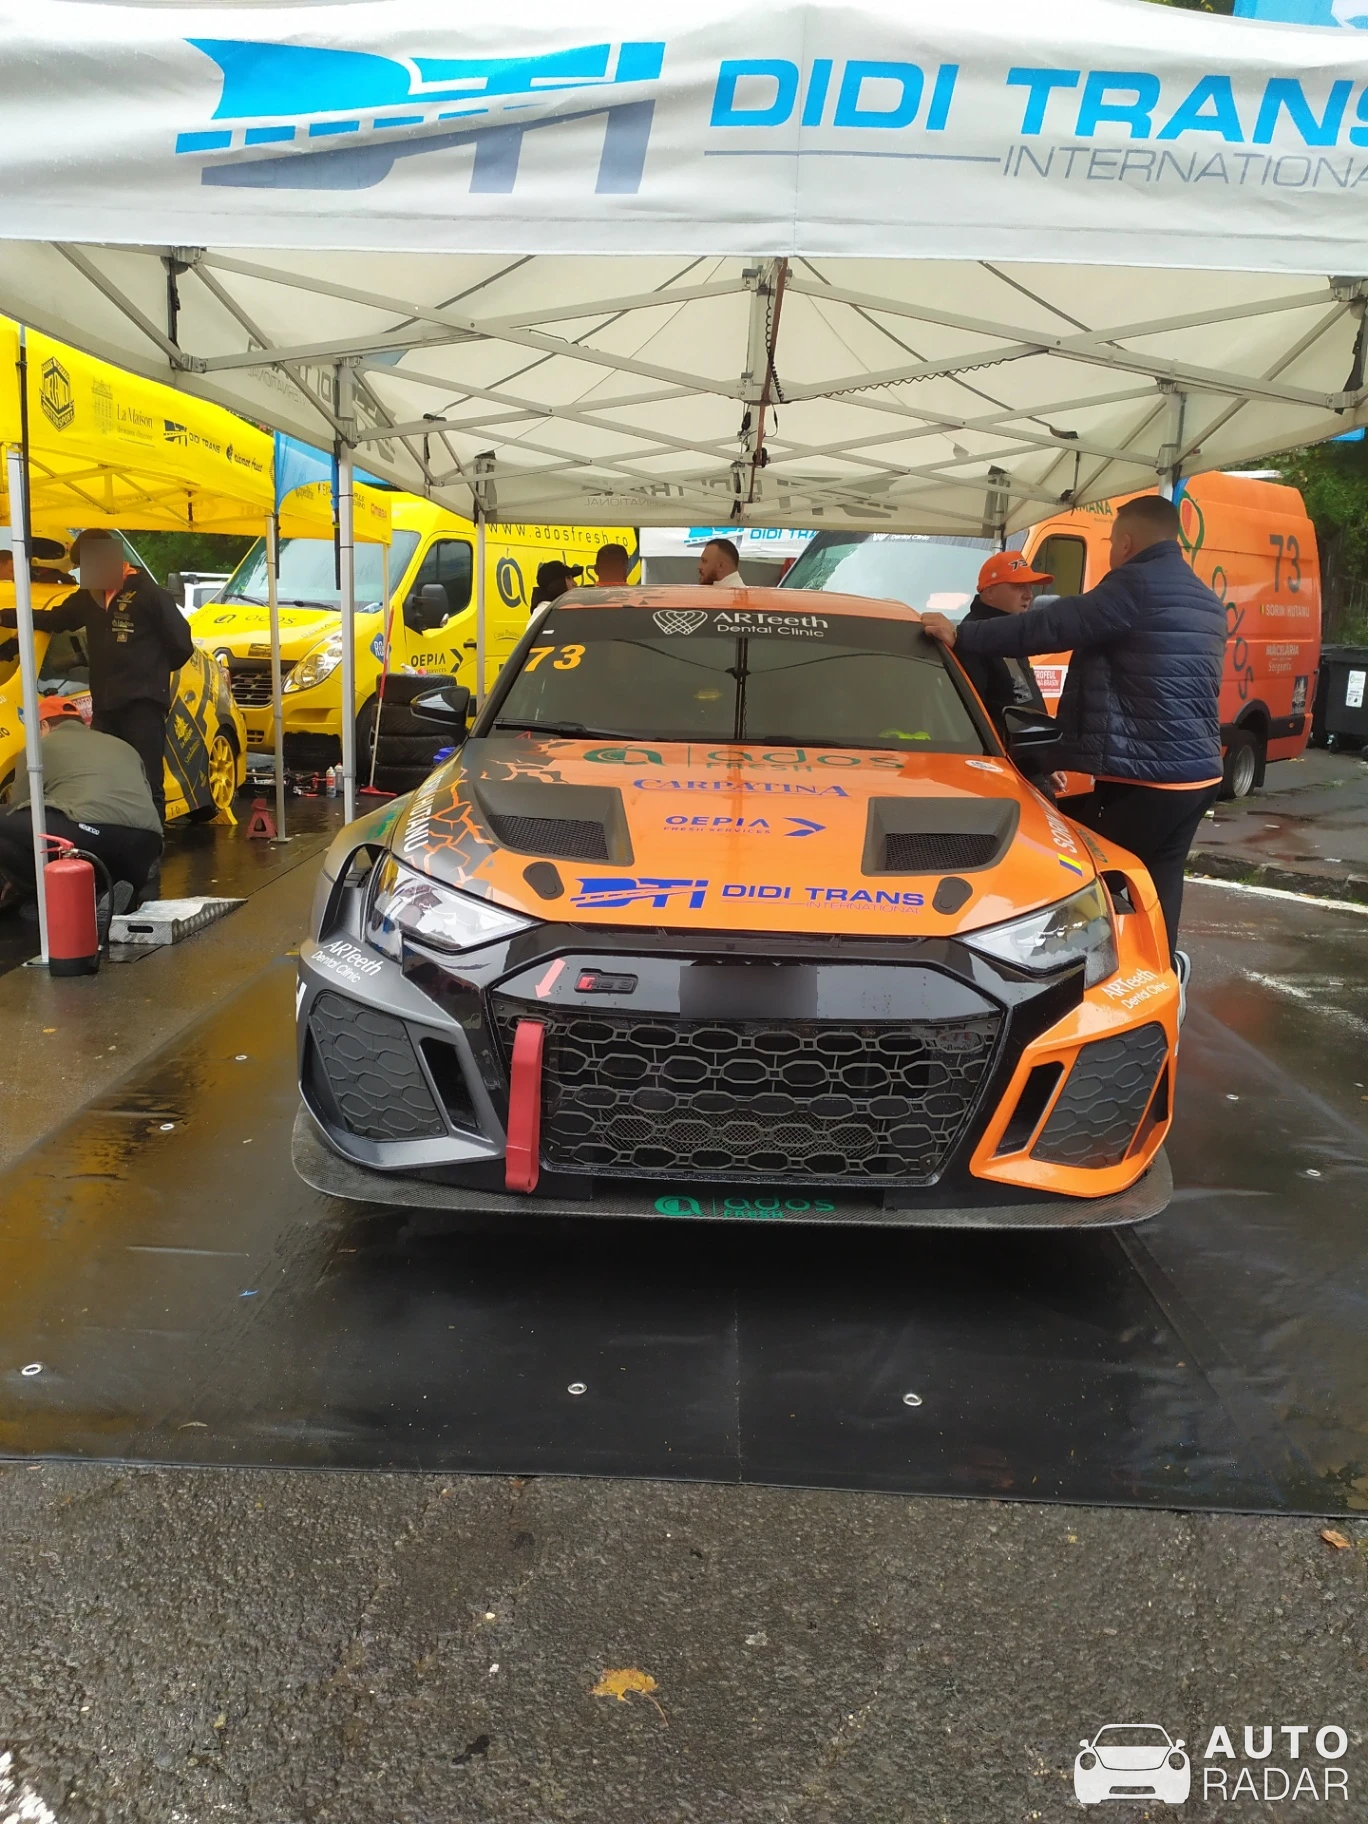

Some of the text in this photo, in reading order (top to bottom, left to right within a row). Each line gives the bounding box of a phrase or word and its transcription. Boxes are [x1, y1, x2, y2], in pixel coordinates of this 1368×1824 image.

[710, 59, 959, 130] DIDI
[202, 438, 221, 453] TRANS
[750, 528, 782, 540] DIDI
[1008, 559, 1029, 571] 73
[1269, 534, 1301, 593] 73
[713, 612, 829, 629] ARTeeth
[717, 624, 824, 638] Dental Clinic
[411, 653, 446, 667] OEPIA
[523, 645, 586, 672] 73
[706, 763, 812, 772] FRESH
[707, 749, 904, 769] ados
[633, 778, 849, 797] CARPATINA
[665, 816, 770, 829] OEPIA
[708, 827, 771, 835] SERVICES
[722, 885, 924, 906] DIDI TRANS
[806, 902, 922, 914] INTERNATIONAL
[311, 950, 361, 983] Dental Clinic
[323, 940, 383, 976] ARTeeth
[1101, 968, 1158, 1000] ARTeeth
[1121, 981, 1170, 1010] Dental Clinic
[724, 1195, 835, 1212] ados
[723, 1209, 784, 1219] FRESH
